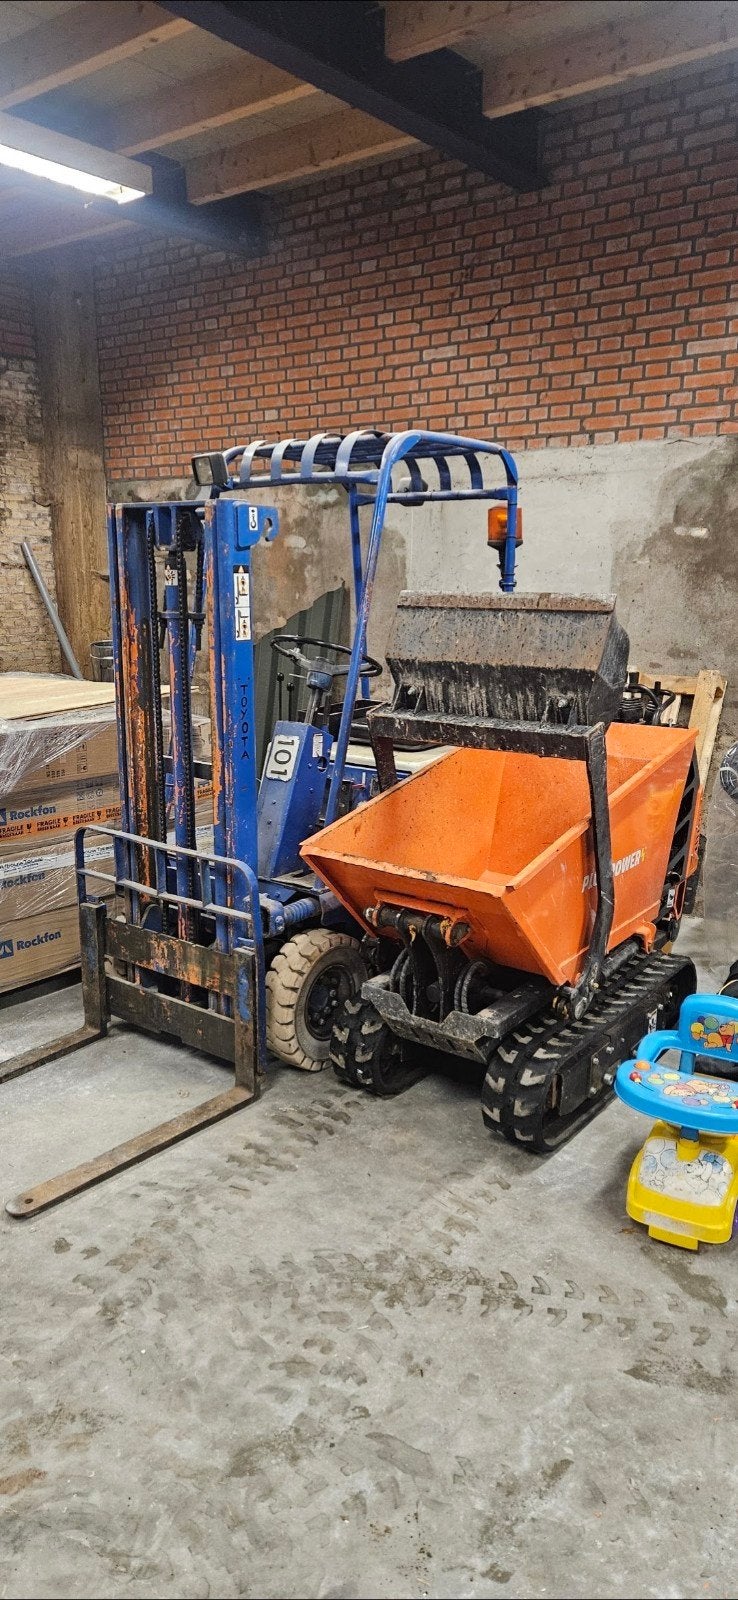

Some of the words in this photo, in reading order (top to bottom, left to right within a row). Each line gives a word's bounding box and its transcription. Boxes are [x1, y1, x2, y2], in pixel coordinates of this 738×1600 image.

[240, 684, 250, 760] TOYOTA
[270, 739, 295, 776] 101
[9, 805, 57, 821] Rockfon
[36, 818, 61, 828] FRAGILE
[16, 931, 62, 951] Rockfon
